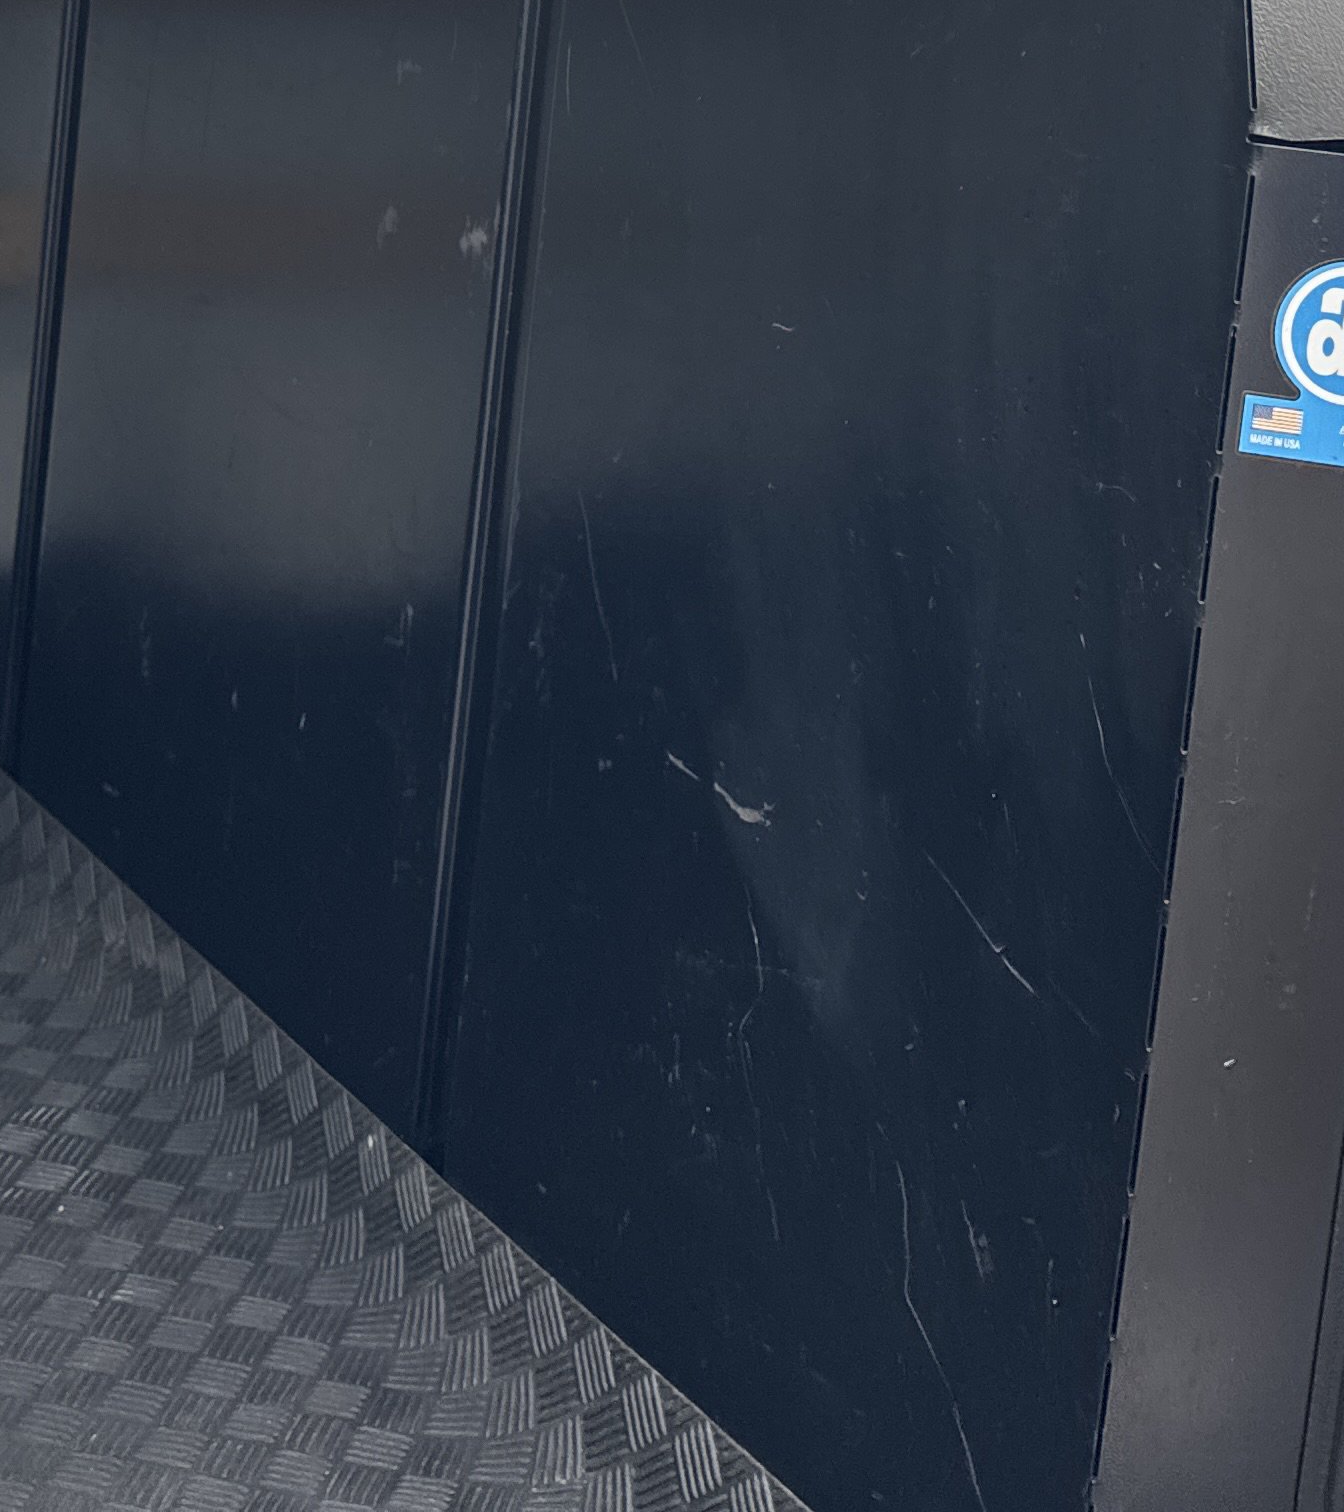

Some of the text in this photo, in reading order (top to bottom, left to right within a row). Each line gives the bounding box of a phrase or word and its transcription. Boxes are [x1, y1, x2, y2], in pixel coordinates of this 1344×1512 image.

[1249, 433, 1301, 450] MADE IN USA
